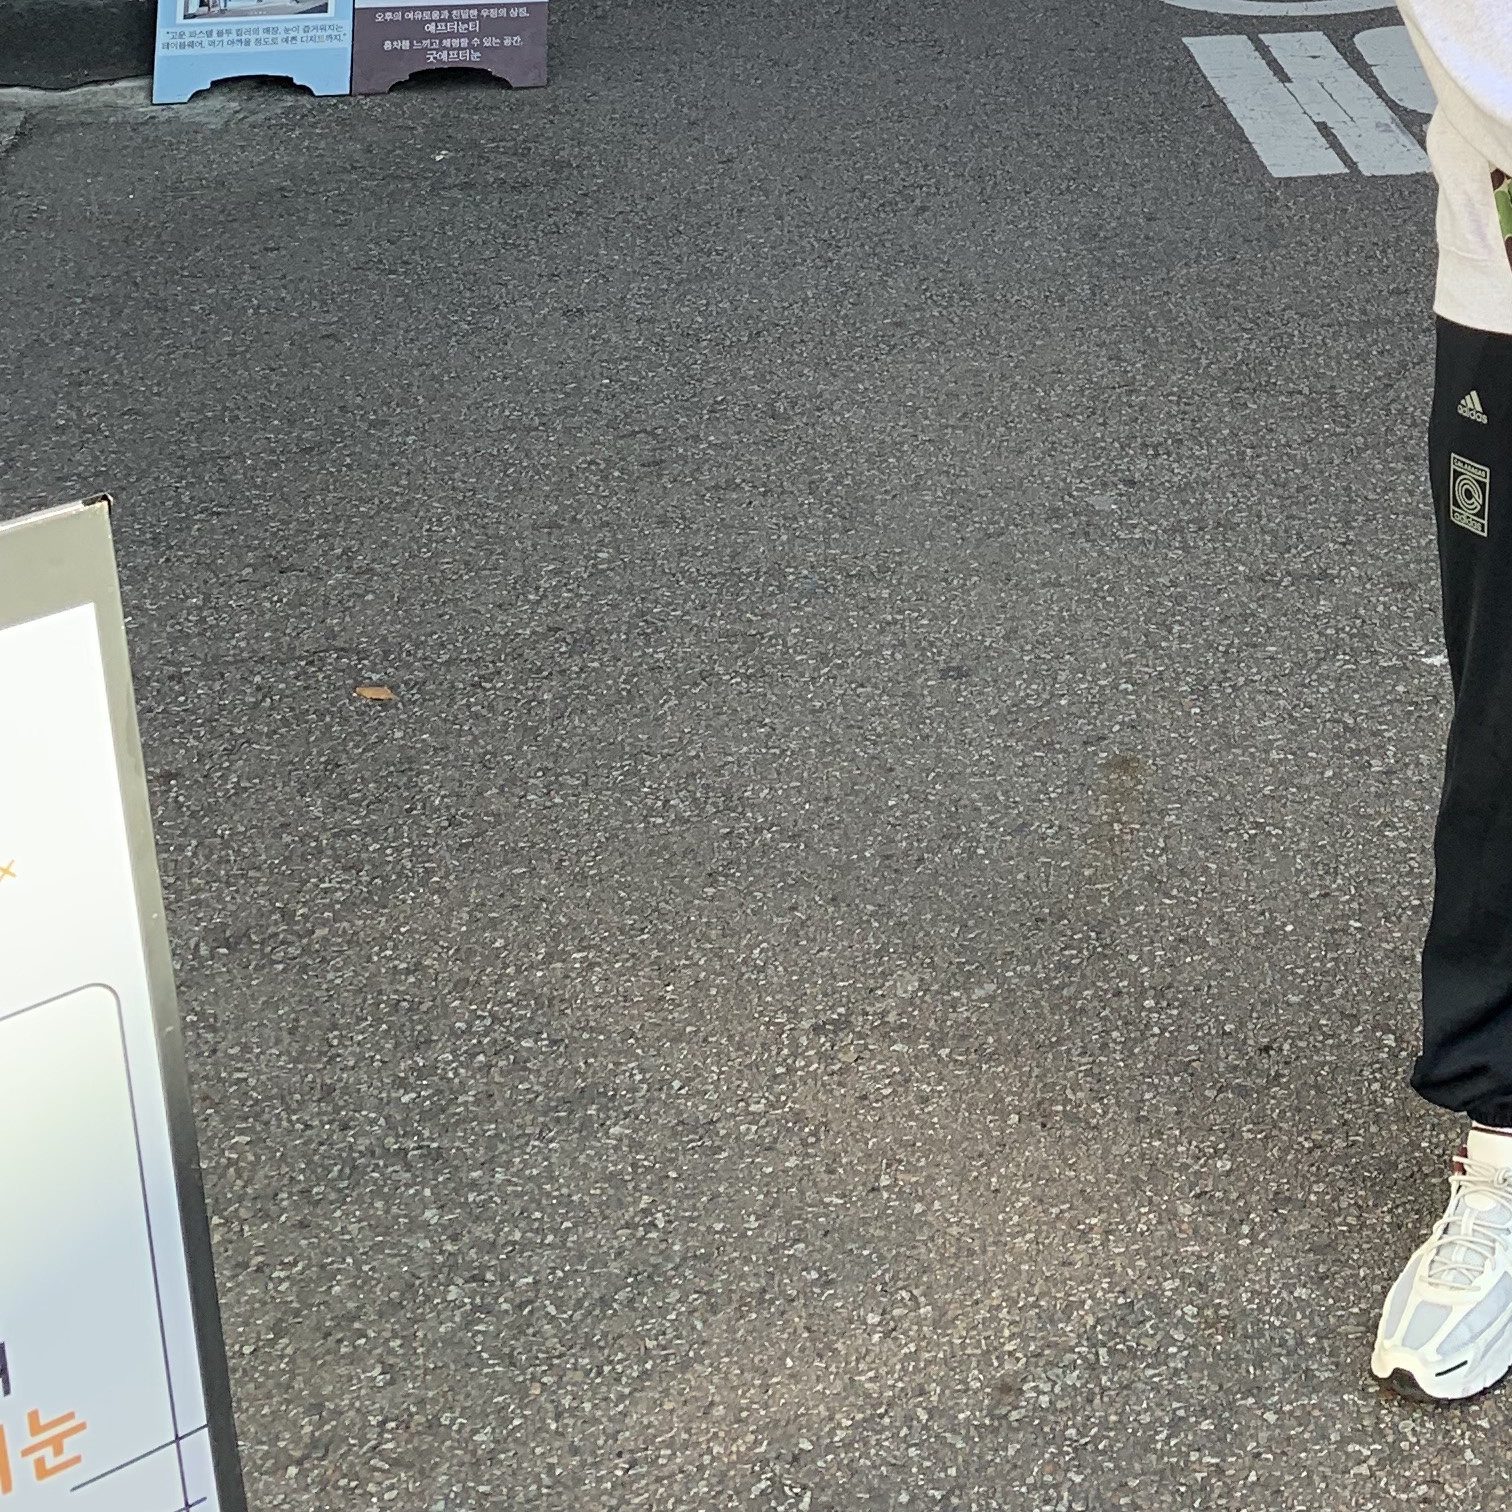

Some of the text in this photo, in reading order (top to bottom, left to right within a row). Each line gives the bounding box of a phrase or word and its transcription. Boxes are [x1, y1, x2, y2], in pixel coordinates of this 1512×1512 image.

[426, 50, 482, 63] 굿애프터눈
[1457, 404, 1488, 424] adidas
[1454, 513, 1482, 531] adidas
